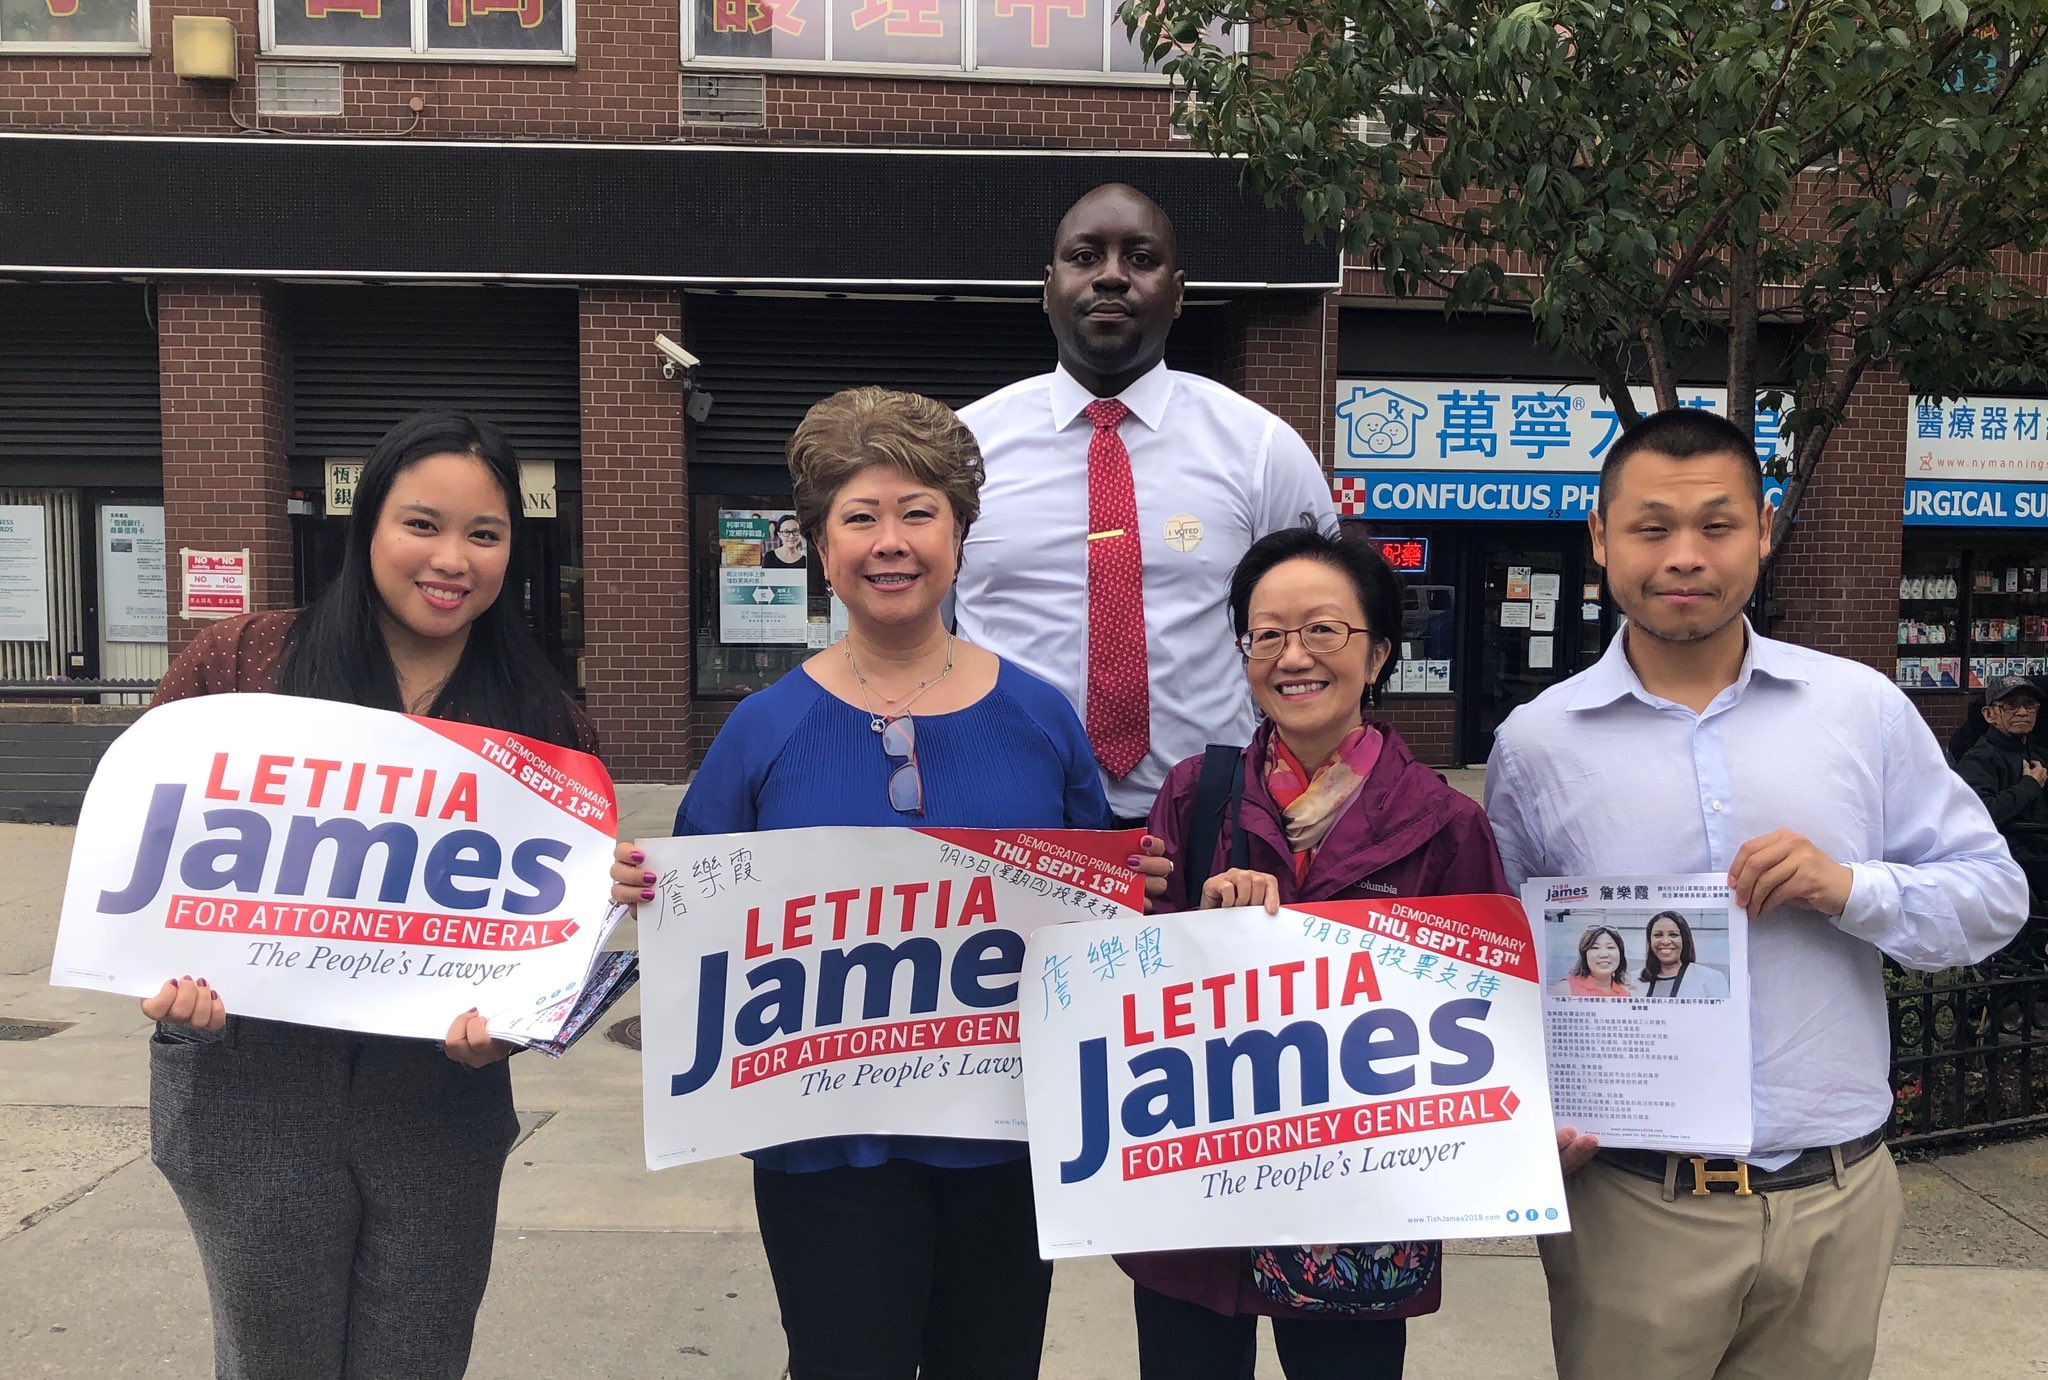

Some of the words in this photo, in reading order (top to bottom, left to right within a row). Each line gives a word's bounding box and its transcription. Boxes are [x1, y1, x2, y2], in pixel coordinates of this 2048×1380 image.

[1916, 404, 2048, 441] 醫療器材
[1371, 483, 1551, 511] CONFUCIUS
[1548, 509, 1560, 518] 25
[1903, 490, 2007, 517] URGICAL
[194, 556, 208, 564] NO
[1383, 541, 1422, 567] 配藥
[204, 752, 479, 823] LETITIA
[481, 738, 517, 775] THU,
[519, 766, 564, 805] SEPT.
[566, 796, 605, 820] 13TH
[504, 737, 567, 784] DEMOCRATIC
[566, 778, 613, 810] PRIMARY
[96, 783, 573, 915] James
[993, 839, 1032, 868] THU,
[1036, 855, 1086, 885] SEPT.
[1088, 873, 1131, 896] 13TH
[1017, 833, 1088, 865] DEMOCRATIC
[1088, 857, 1138, 883] PRIMARY
[656, 847, 762, 932] 詹樂霞
[745, 876, 997, 960] LETITIA
[1545, 886, 1588, 902] James
[1599, 884, 1650, 901] 詹樂霞
[174, 901, 240, 928] FOR
[251, 905, 412, 940] ATTORNEY
[423, 917, 554, 947] GENERAL
[1367, 910, 1410, 942] THU,
[1415, 927, 1472, 959] SEPT.
[1476, 946, 1520, 967] 13TH
[1391, 903, 1470, 935] DEMOCRATIC
[1471, 927, 1527, 952] PRIMARY
[247, 941, 304, 968] The
[418, 953, 521, 987] Lawyer
[1042, 925, 1173, 1021] 詹樂霞
[671, 927, 1025, 1097] Jame
[1122, 950, 1383, 1048] LETITIA
[737, 1050, 787, 1080] FOR
[797, 1021, 947, 1067] ATTORNEY
[957, 1015, 1022, 1045] GEN
[800, 1068, 846, 1097] The
[955, 1053, 1024, 1079] Lawy
[1060, 998, 1497, 1184] James
[1128, 1143, 1184, 1175] FOR
[1193, 1113, 1343, 1163] ATTORNEY
[1353, 1093, 1494, 1135] GENERAL
[1201, 1172, 1247, 1199] The
[1360, 1139, 1466, 1180] Lawyer
